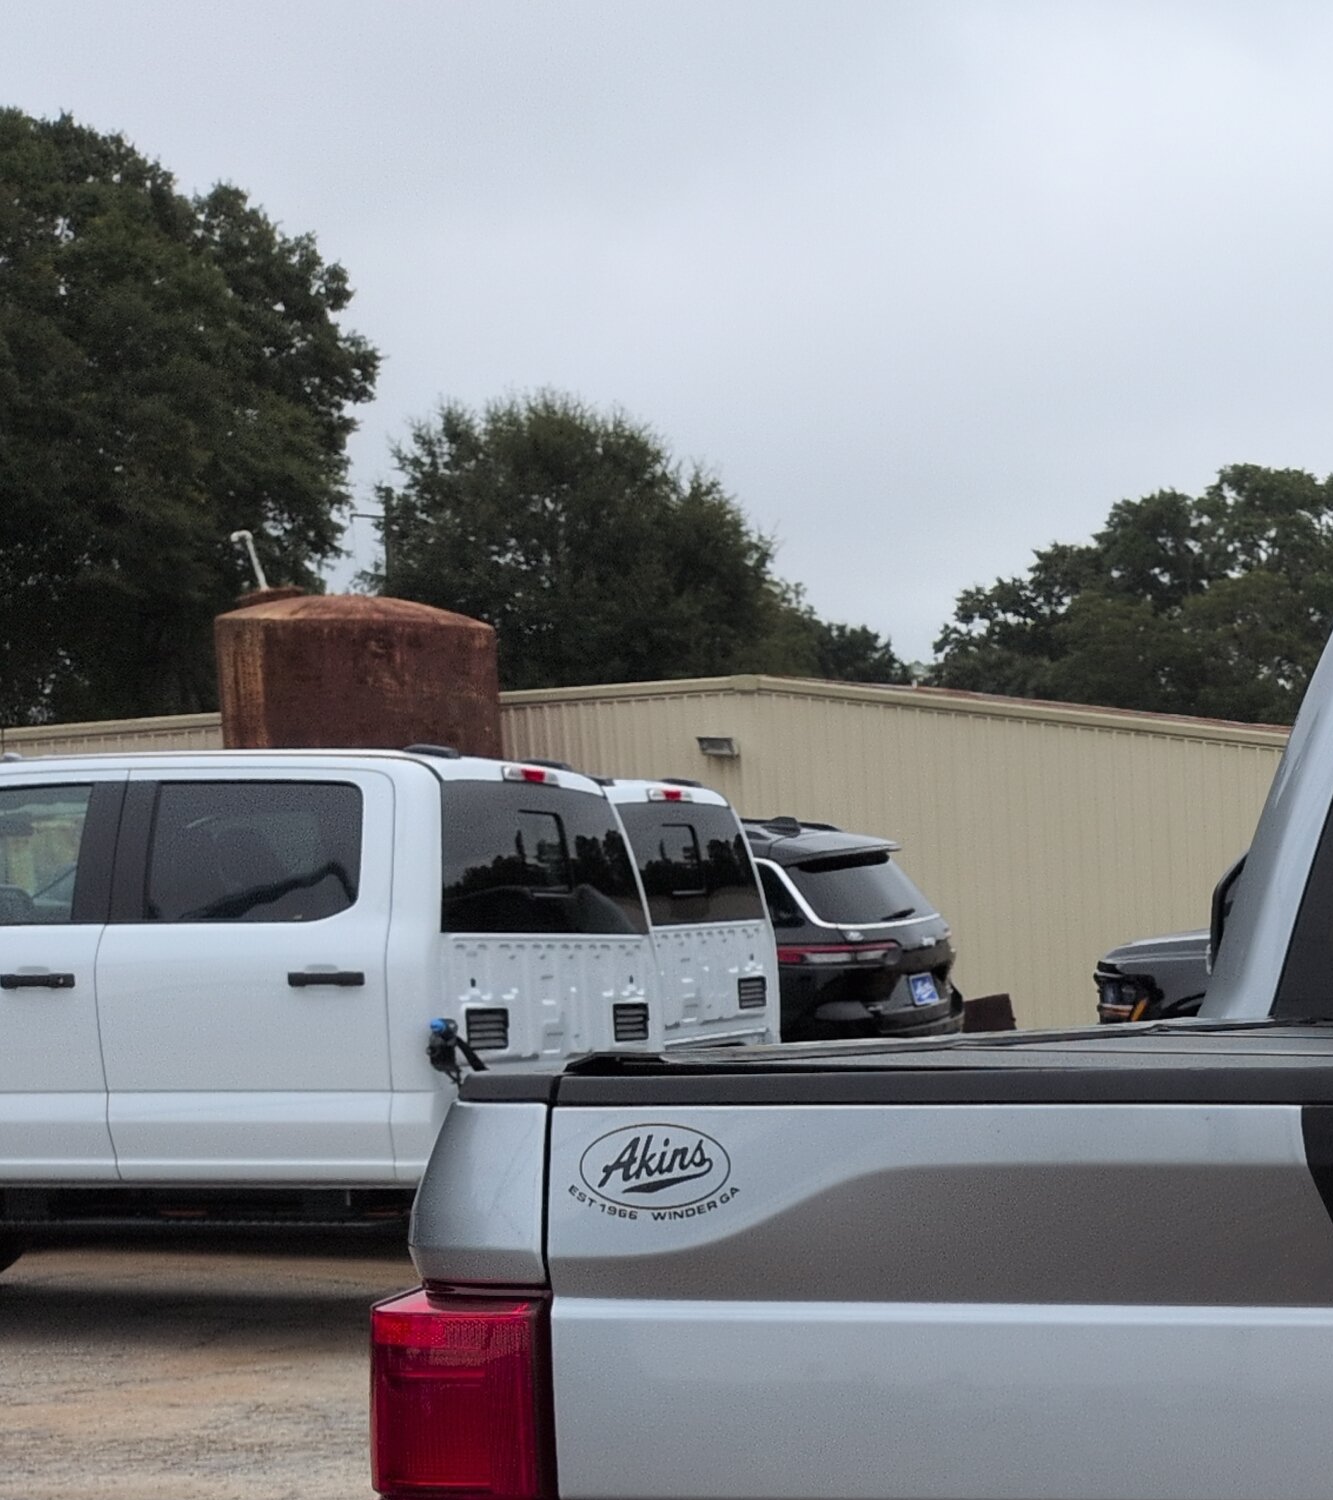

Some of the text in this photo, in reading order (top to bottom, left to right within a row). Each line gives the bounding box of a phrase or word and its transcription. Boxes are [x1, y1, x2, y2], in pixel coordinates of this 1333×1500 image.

[597, 1134, 713, 1193] Akins
[567, 1184, 741, 1221] EST 1966 WINDER GA
